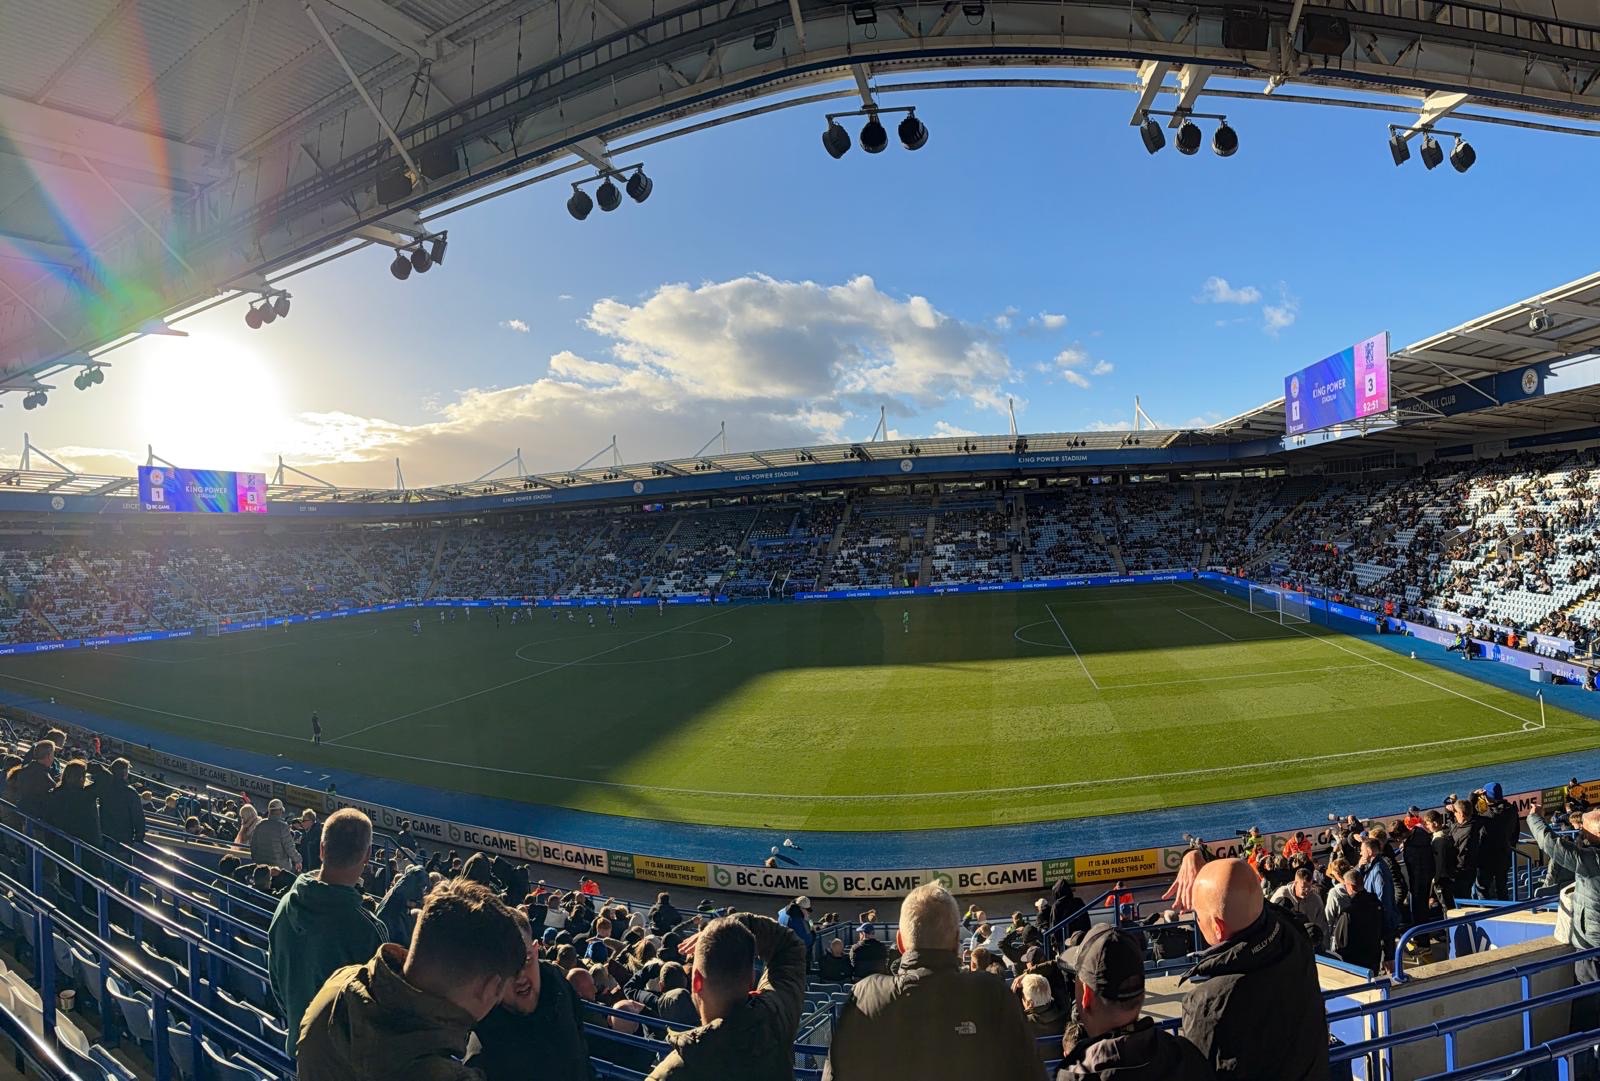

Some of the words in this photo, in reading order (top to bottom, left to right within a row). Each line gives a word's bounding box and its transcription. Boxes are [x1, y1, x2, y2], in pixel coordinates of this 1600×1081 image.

[1312, 384, 1326, 399] KING
[1326, 378, 1346, 394] POWER
[1368, 378, 1374, 392] 3
[1440, 395, 1456, 406] CLUB
[199, 766, 227, 782] BC.GAME
[240, 777, 271, 792] BC.GAME
[464, 830, 517, 852] BC.GAME
[543, 846, 604, 867] BC.GAME
[1110, 855, 1144, 865] ARRESTABLE
[636, 868, 657, 877] OFFENCE
[690, 874, 706, 882] POINT
[664, 863, 695, 872] ARRESTABLE
[1077, 870, 1102, 878] OFFENCE
[736, 872, 808, 890] BC.GAME
[843, 876, 920, 892] BC.GAME
[958, 868, 1038, 888] BC.GAME
[1251, 938, 1268, 954] HELLY
